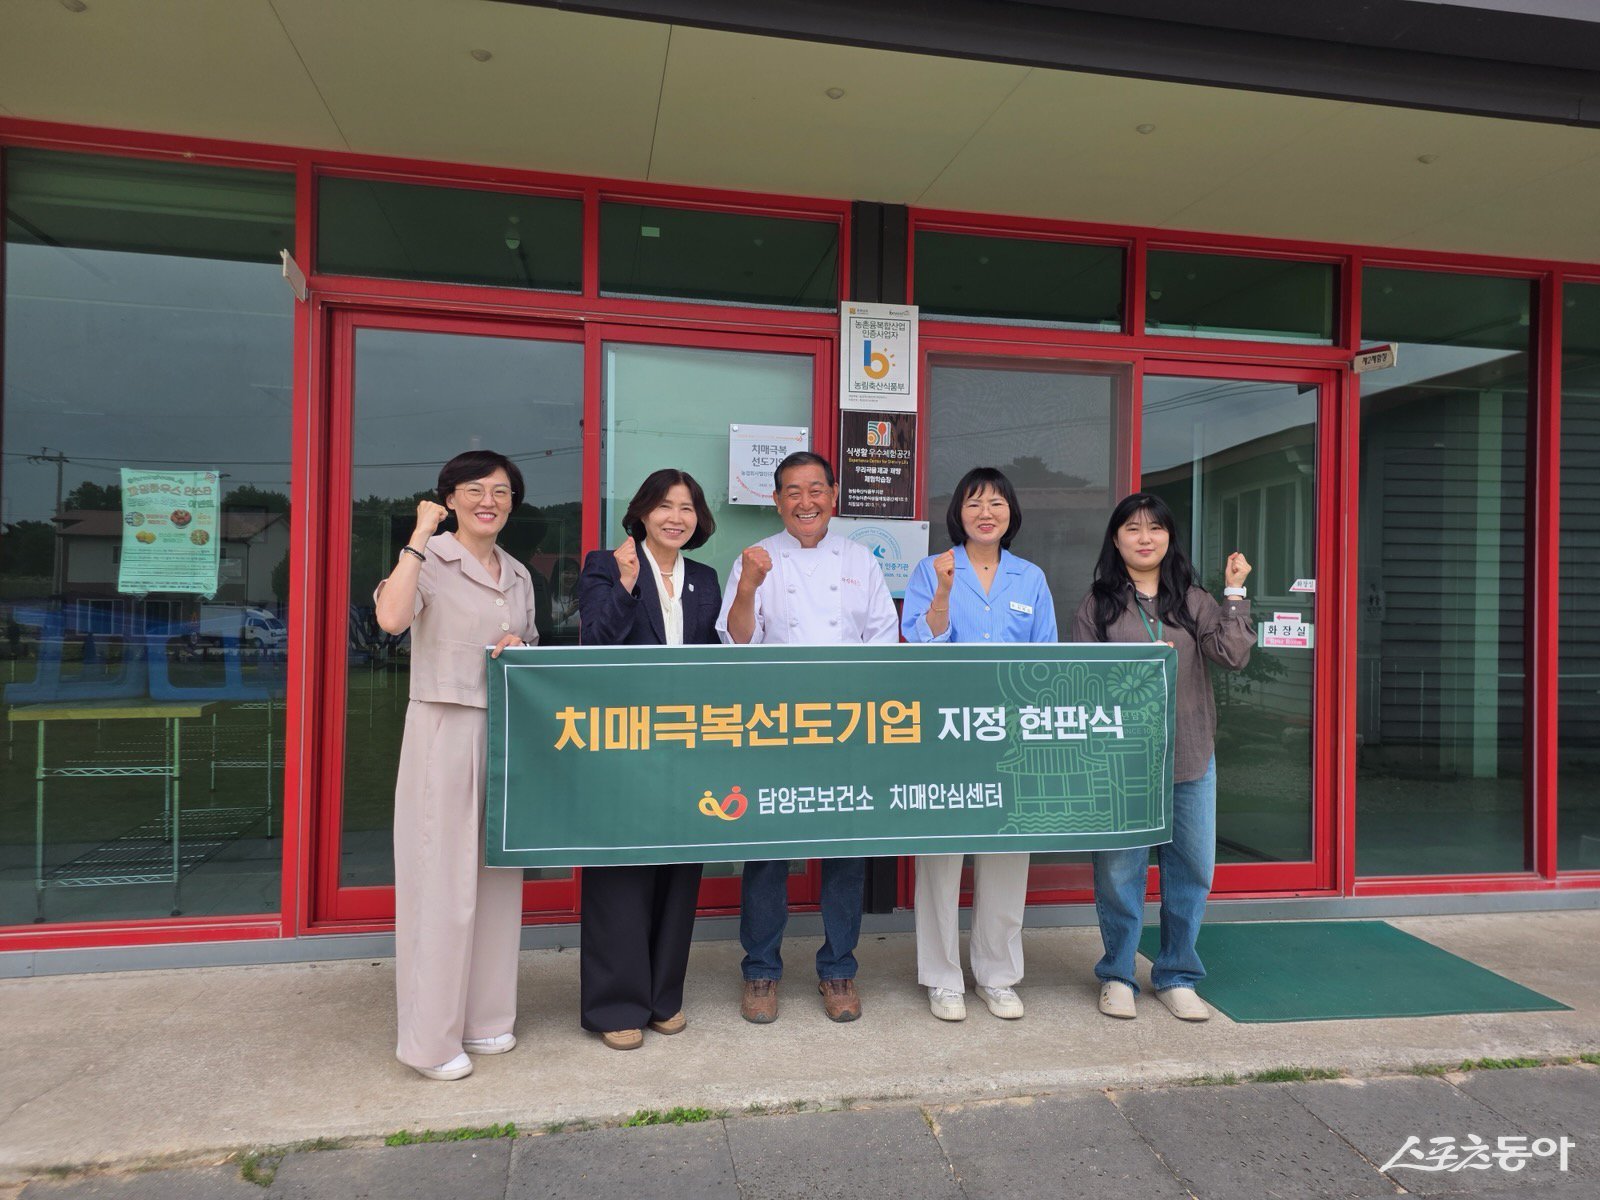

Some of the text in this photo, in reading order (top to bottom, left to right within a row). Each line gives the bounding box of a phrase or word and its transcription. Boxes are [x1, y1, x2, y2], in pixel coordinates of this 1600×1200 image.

[855, 320, 906, 332] 농촌융복합산업
[862, 329, 899, 340] 인증사업자
[854, 381, 905, 391] 농림축산식품부
[751, 444, 788, 456] 치매극복
[846, 447, 868, 458] 식생활
[884, 562, 909, 571] 인증기관
[1267, 625, 1306, 637] 화장실
[553, 700, 1125, 752] 치매극복선도기업 지정 현판식
[758, 782, 1003, 815] 담양군보건소 치매안심센터
